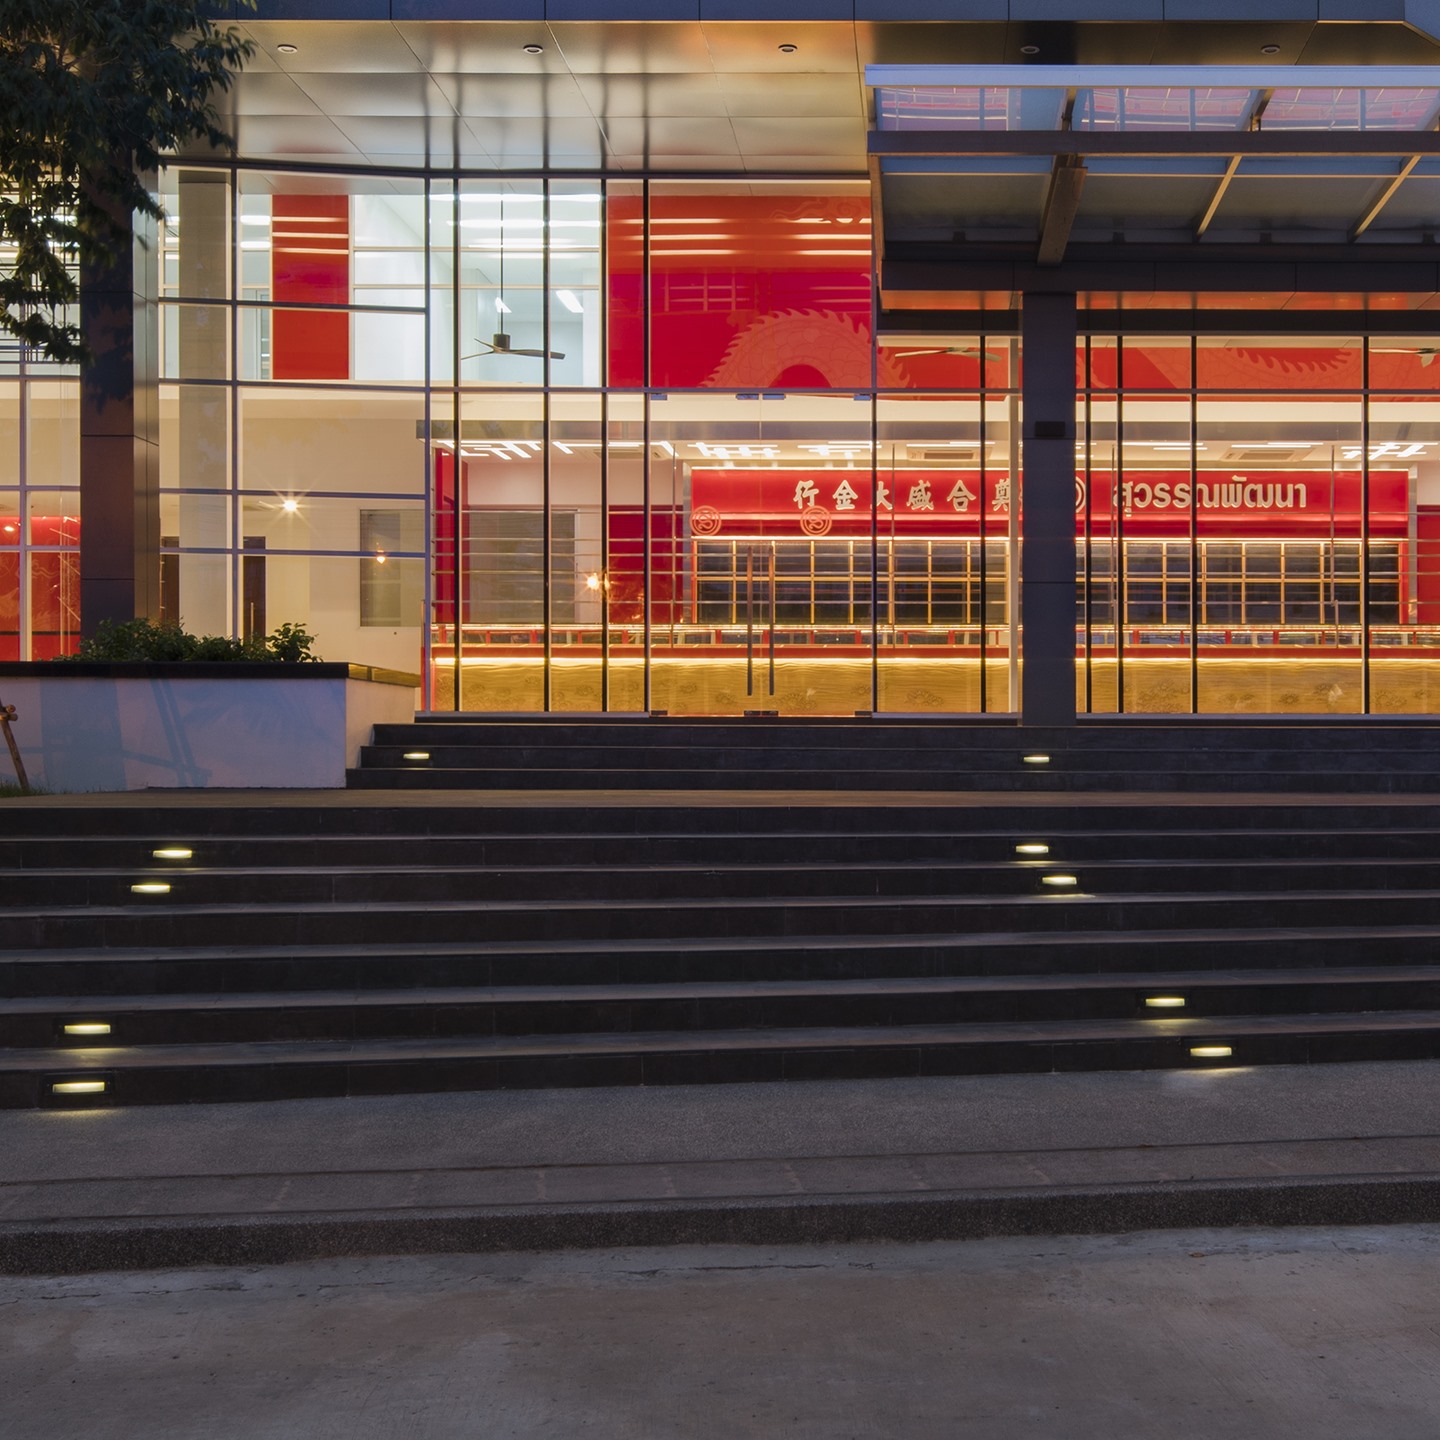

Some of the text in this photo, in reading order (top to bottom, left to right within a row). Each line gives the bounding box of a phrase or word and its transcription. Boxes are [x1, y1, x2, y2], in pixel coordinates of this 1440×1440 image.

[1113, 474, 1308, 517] สุวรรณพัฒนา
